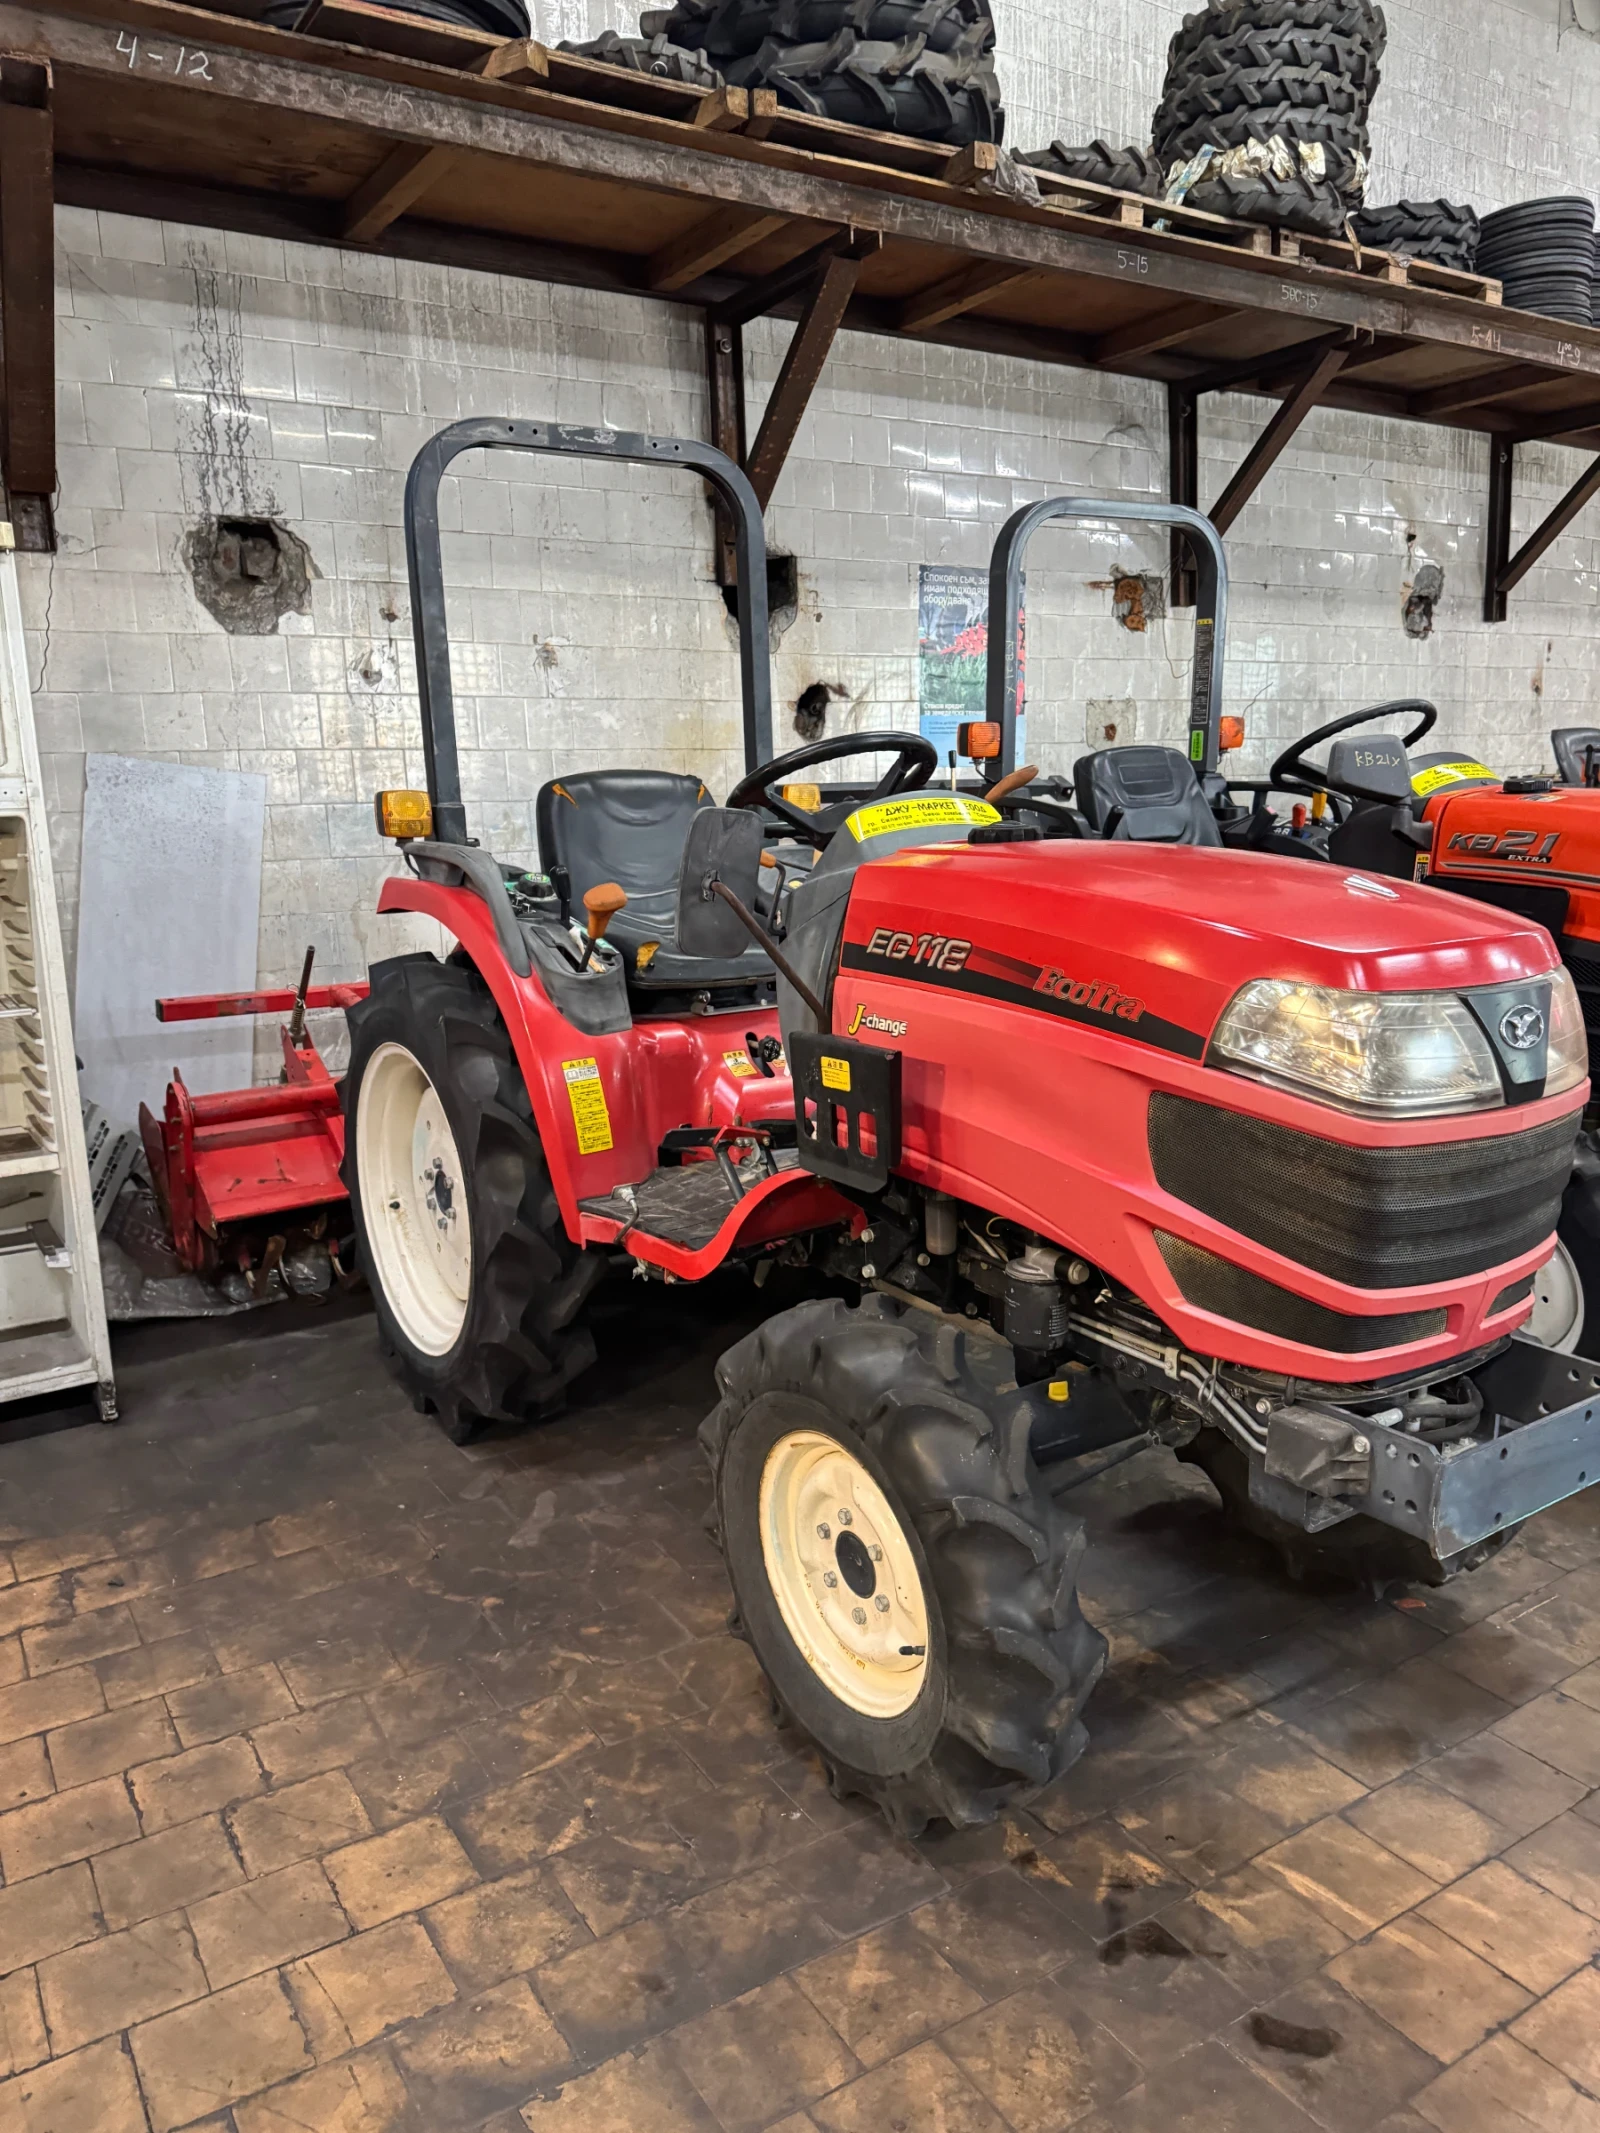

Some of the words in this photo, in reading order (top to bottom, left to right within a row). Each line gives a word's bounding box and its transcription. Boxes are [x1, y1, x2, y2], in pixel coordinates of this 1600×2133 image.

[116, 31, 213, 80] 4-12
[1117, 250, 1148, 273] 5-15
[923, 572, 958, 584] Спокоен
[923, 585, 946, 593] имам
[1447, 830, 1560, 855] KB21
[1507, 854, 1548, 864] EXTRA
[1032, 965, 1147, 1023] EcoTra
[847, 1003, 908, 1036] J-change
